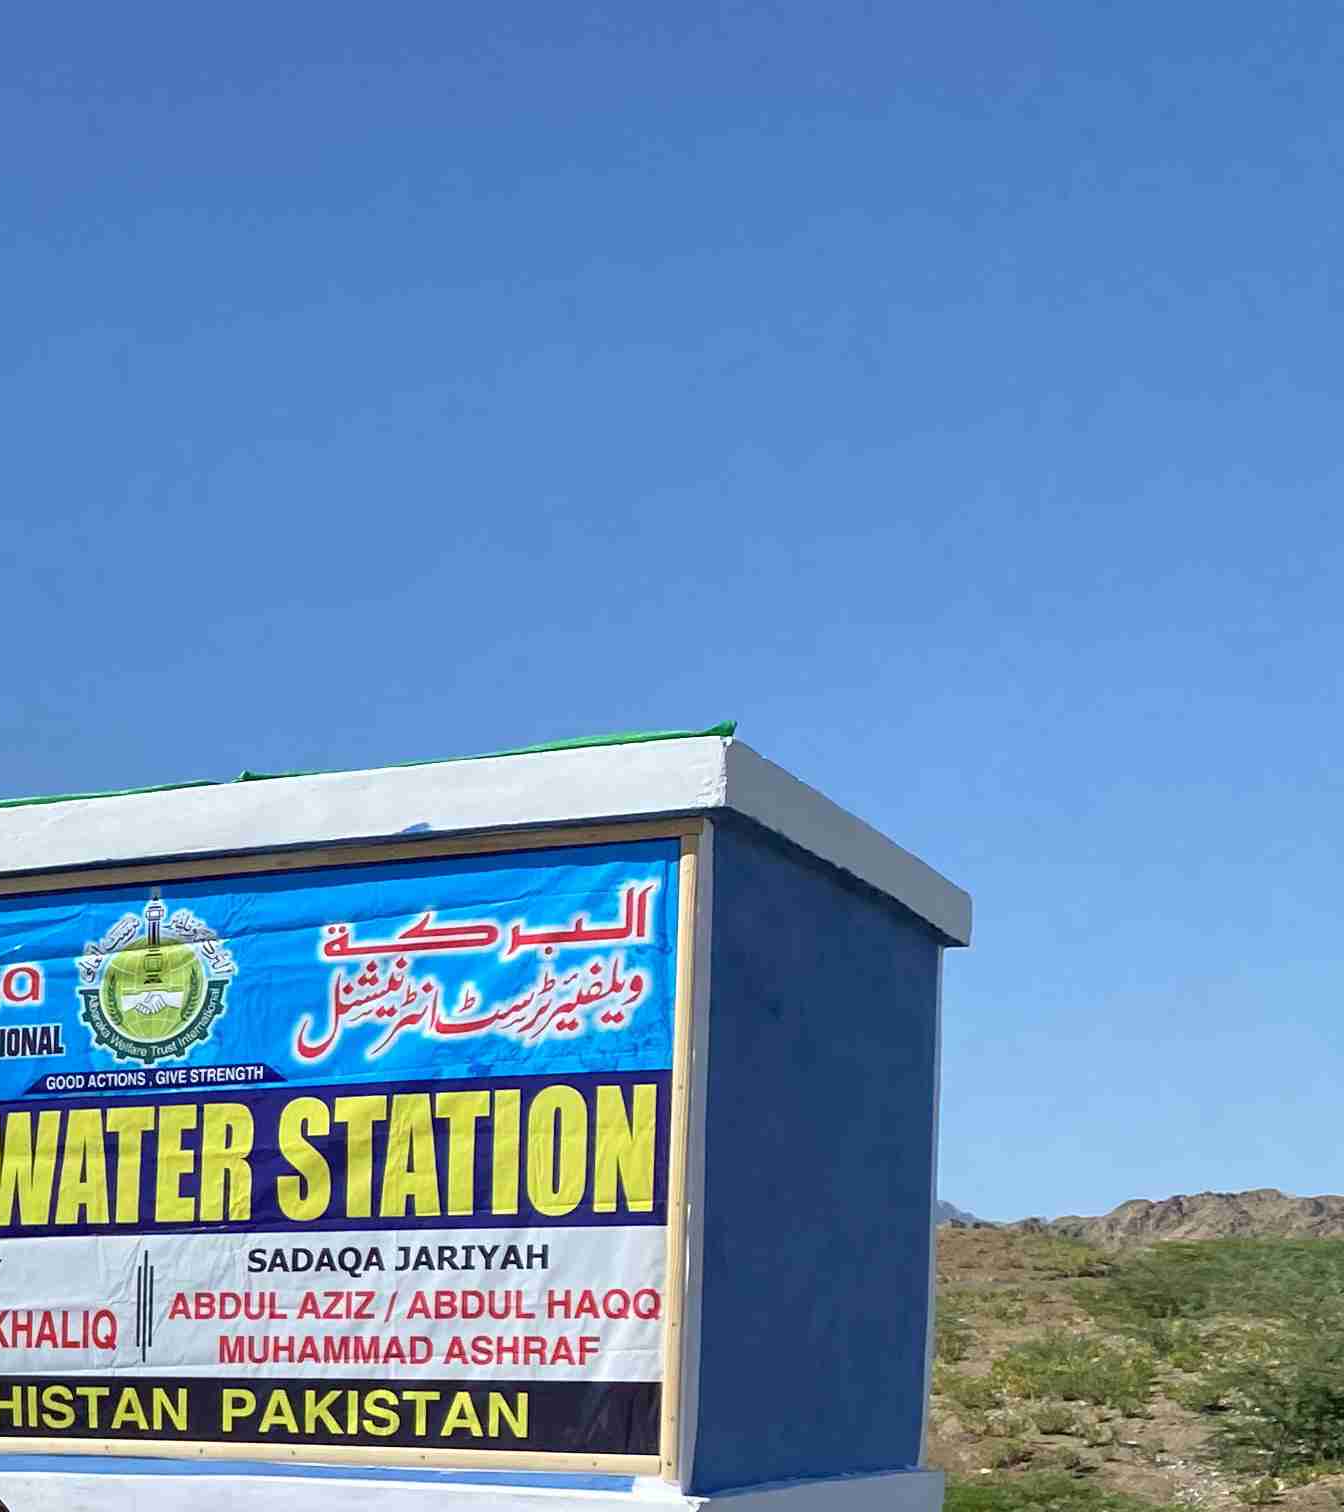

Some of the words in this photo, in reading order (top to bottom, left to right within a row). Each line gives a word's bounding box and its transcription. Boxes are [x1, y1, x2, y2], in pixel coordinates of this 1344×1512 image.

[109, 1033, 148, 1057] Welfare
[151, 1042, 178, 1056] Trust
[179, 987, 220, 1047] International
[45, 1073, 85, 1090] GOOD
[87, 1071, 146, 1088] ACTIONS
[155, 1069, 187, 1085] GIVE
[190, 1065, 264, 1083] STRENGTH
[276, 1083, 658, 1222] STATION
[247, 1246, 384, 1278] SADAQA
[396, 1244, 549, 1272] JARIYAH
[168, 1291, 287, 1321] ABDUL
[297, 1290, 375, 1320] AZIZ
[384, 1290, 399, 1324] /
[407, 1289, 536, 1321] ABDUL
[547, 1287, 661, 1321] HAQQ
[219, 1335, 433, 1366] MUHAMMAD
[444, 1335, 601, 1367] ASHRAF
[221, 1388, 530, 1439] PAKISTAN
